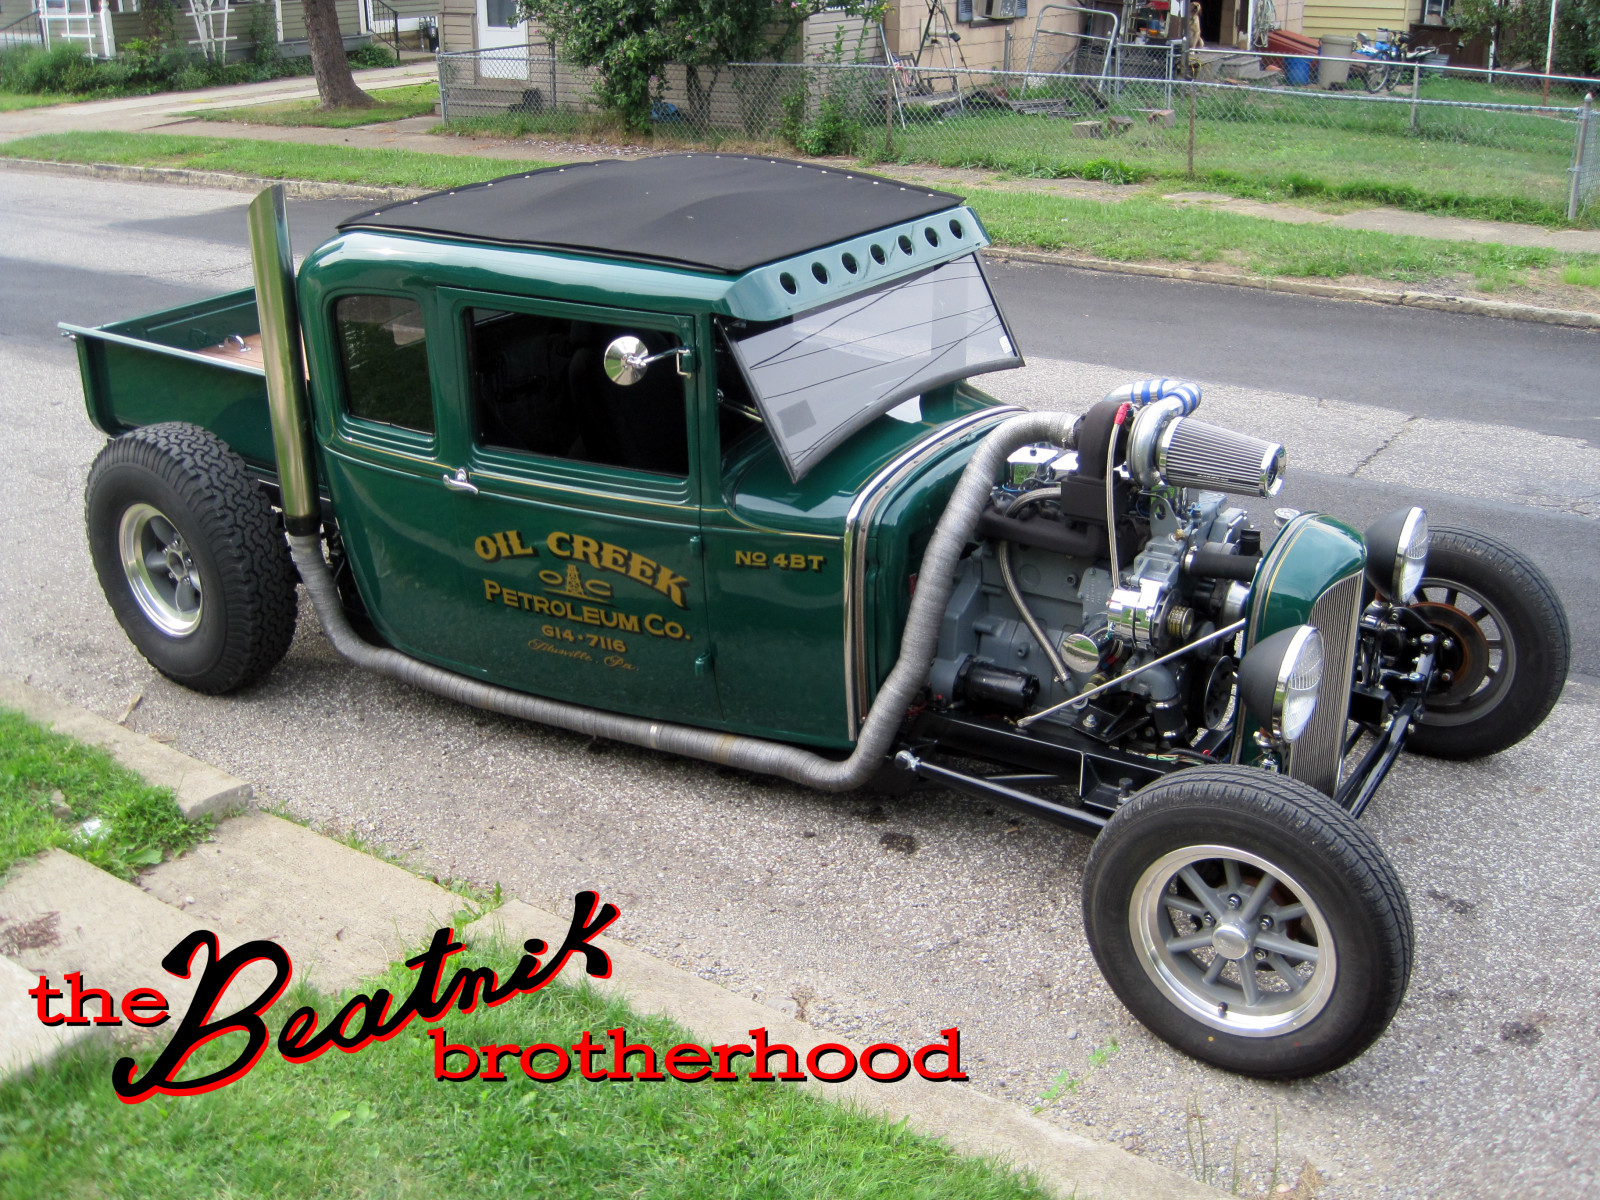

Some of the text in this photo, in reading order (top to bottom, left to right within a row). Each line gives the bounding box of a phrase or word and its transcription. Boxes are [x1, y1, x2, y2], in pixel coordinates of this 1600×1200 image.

[474, 530, 689, 609] OIL CREEK
[773, 553, 825, 571] 4BT
[483, 578, 641, 633] PETROLEUM
